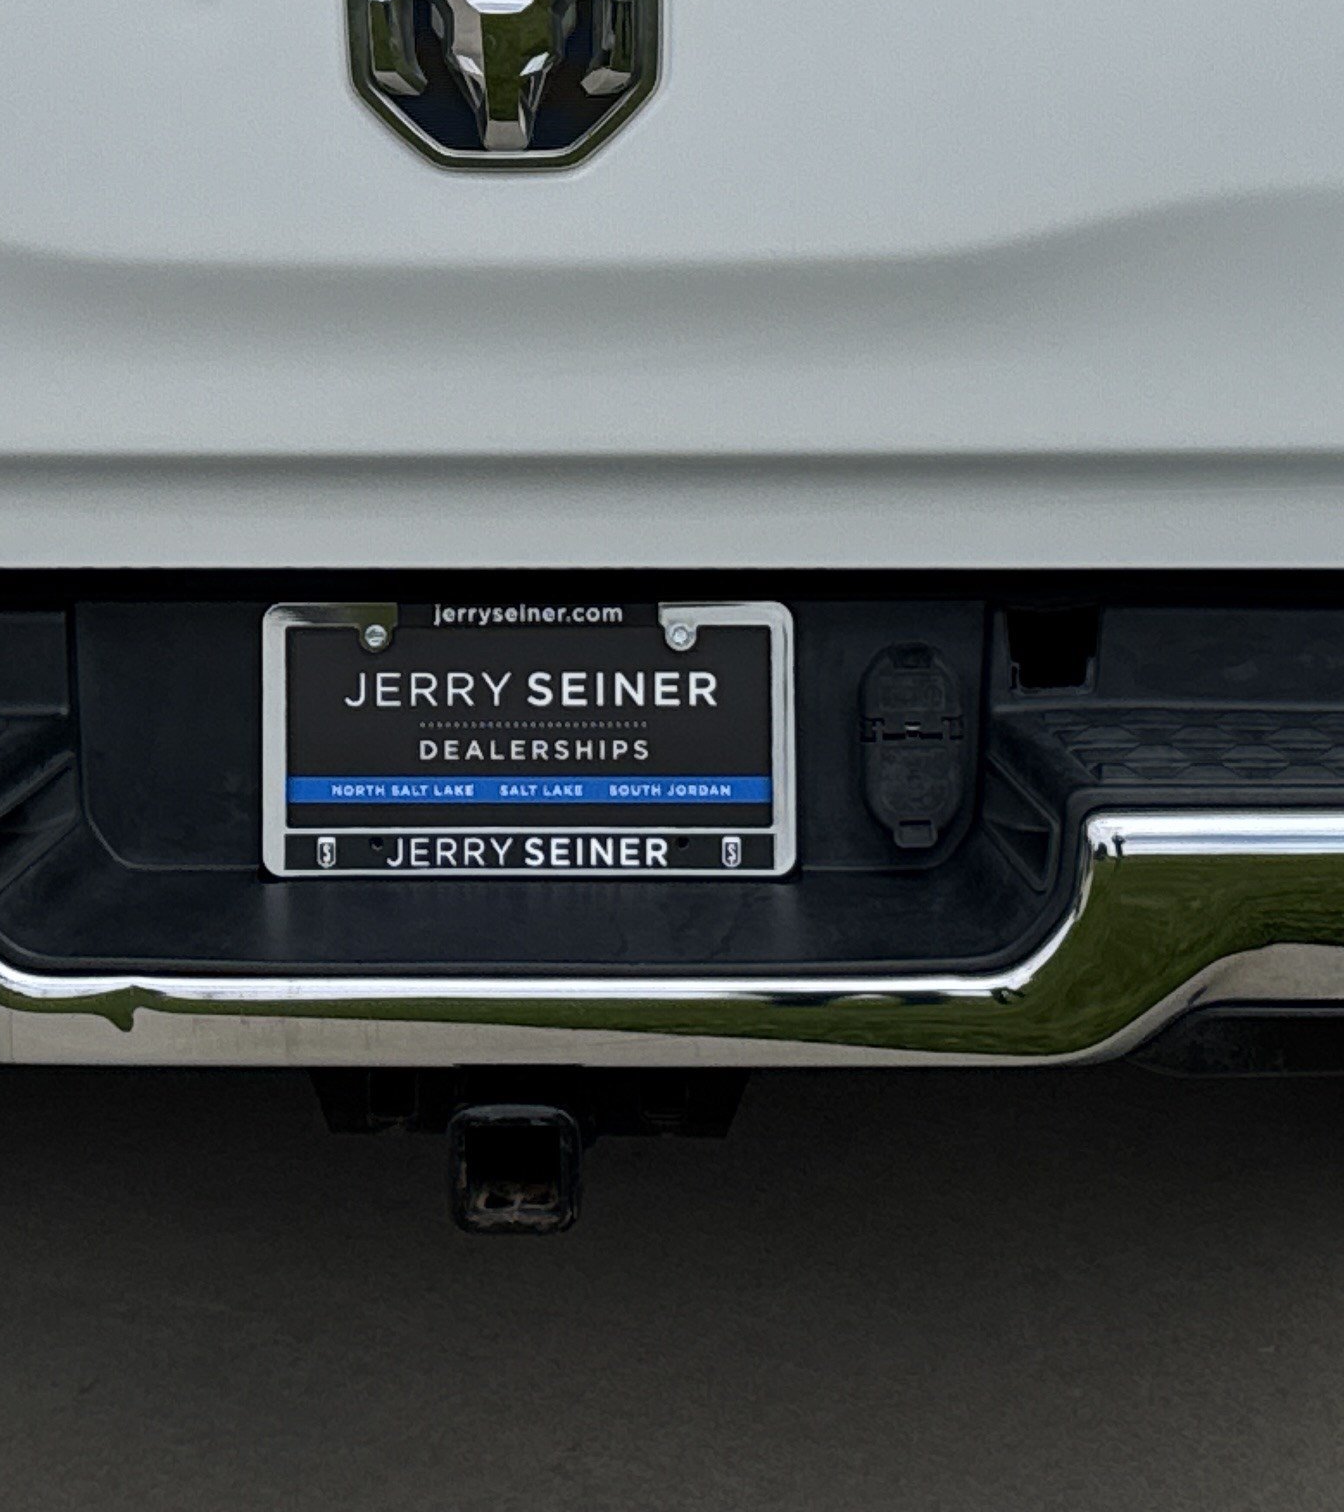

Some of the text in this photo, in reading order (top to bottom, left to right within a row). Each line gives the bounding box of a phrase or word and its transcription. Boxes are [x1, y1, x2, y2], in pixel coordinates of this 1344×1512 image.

[433, 603, 623, 626] jerryseiner.com
[344, 672, 718, 707] JERRY SEINER
[419, 740, 649, 760] DEALERSHIPS
[331, 784, 475, 797] NORTH SALT LAKE
[500, 784, 583, 797] SALT LAKE
[609, 784, 731, 797] SOUTH JORDAN
[386, 838, 668, 867] JERRY SEINER
